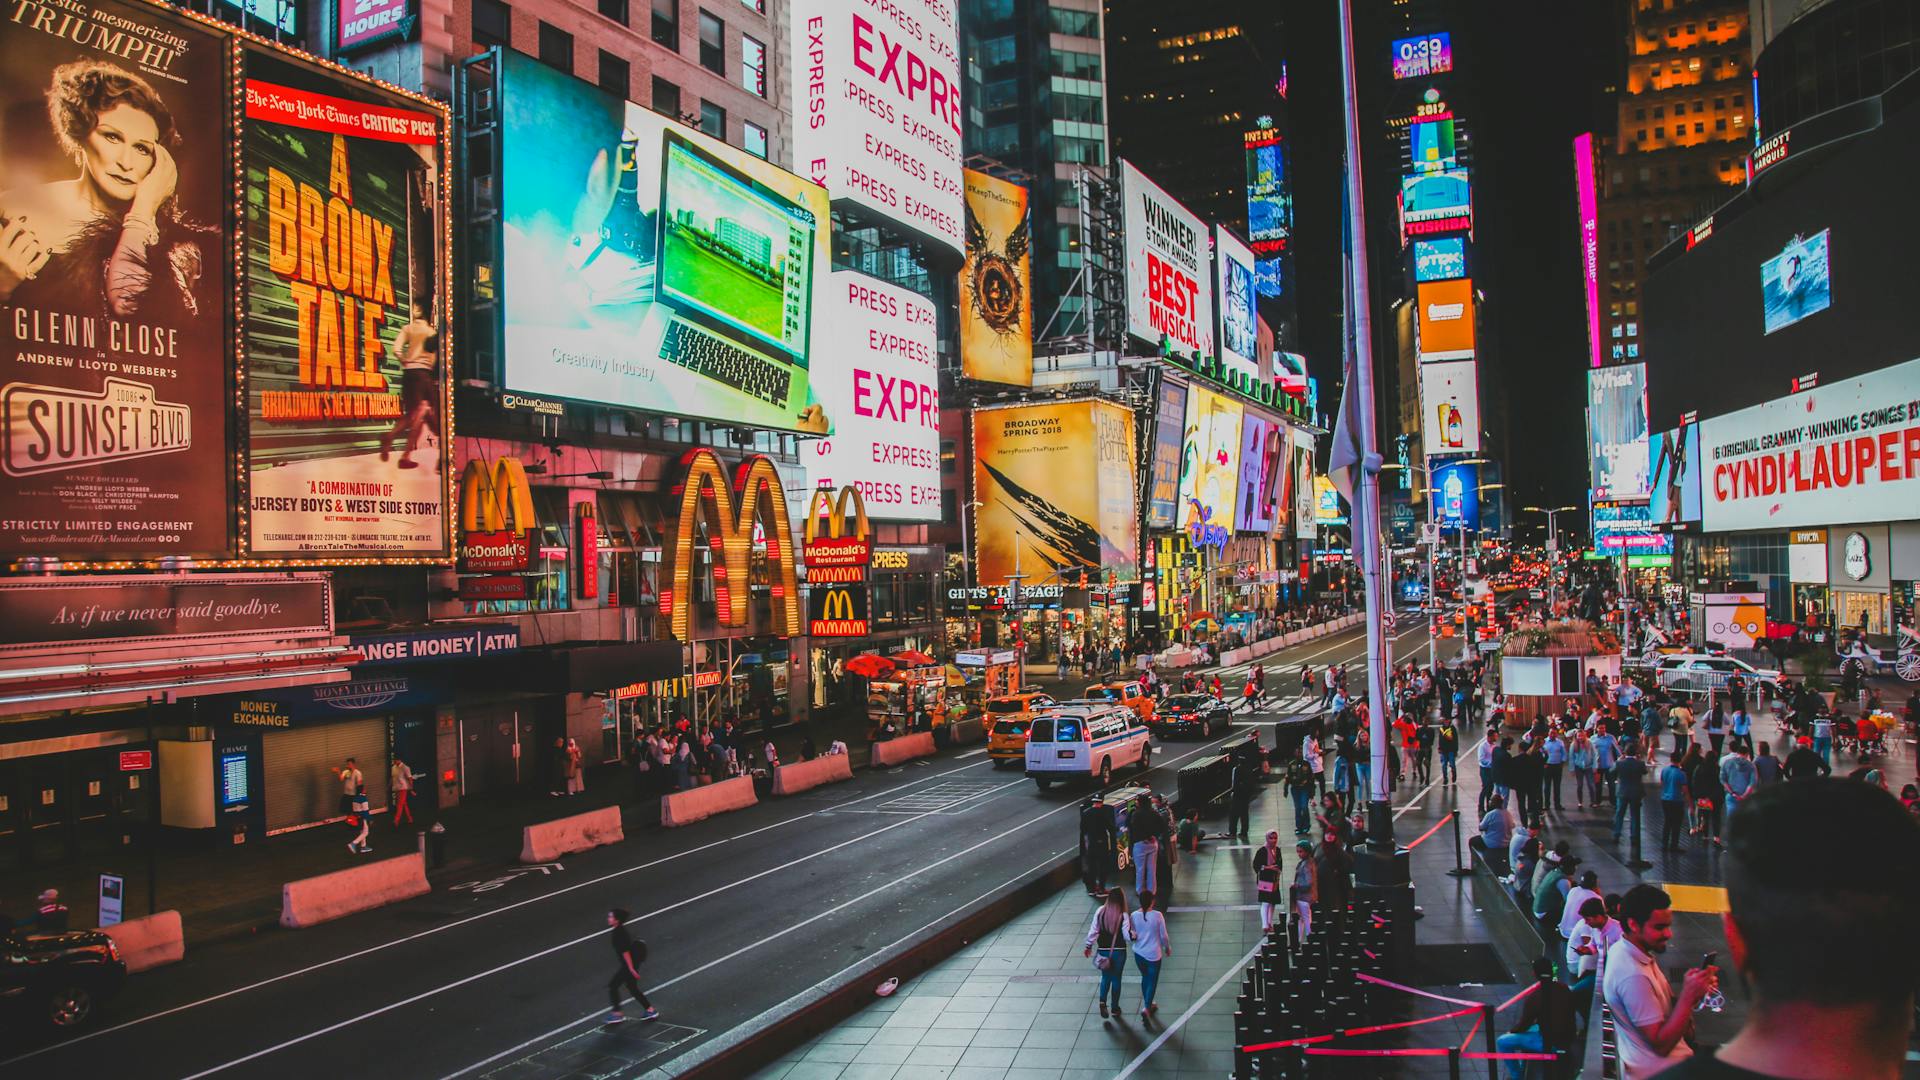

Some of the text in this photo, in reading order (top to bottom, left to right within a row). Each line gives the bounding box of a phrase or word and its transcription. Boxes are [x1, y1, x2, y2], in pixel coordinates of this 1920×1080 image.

[344, 5, 402, 38] HOURS
[864, 0, 922, 40] XPRESS
[1400, 38, 1441, 60] 0:39
[808, 15, 825, 130] EXPRESS
[853, 13, 960, 137] EXPRE
[246, 88, 437, 137] The New York Times CRITICS' PICK
[903, 114, 956, 161] EXPRESS
[1753, 131, 1790, 160] MARRIOTT
[329, 132, 351, 200] A
[865, 133, 926, 181] EXPRESS
[1754, 146, 1785, 172] MARQUIS
[905, 195, 958, 237] EXPRESS
[1143, 192, 1197, 257] WINNER!
[1405, 216, 1470, 235] TOSHIBA
[268, 166, 395, 306] BRONX
[1146, 228, 1197, 272] 6 TONY AWARDS
[1147, 251, 1199, 323] BEST
[15, 307, 177, 358] GLENN CLOSE
[290, 280, 385, 389] TALE
[1150, 301, 1200, 350] MUSICAL
[869, 329, 929, 365] EXPRESS
[17, 352, 177, 378] ANDREW LLOYD WEBBER'S
[552, 347, 655, 382] Creativity Industry
[1591, 371, 1633, 389] What
[261, 390, 330, 419] BROADWAY'S
[332, 392, 352, 417] NEW
[354, 393, 367, 416] HIT
[853, 368, 939, 431] EXPRE
[28, 399, 189, 462] SUNSET BLVD.
[1003, 426, 1062, 437] SPRING 2018
[1004, 418, 1060, 429] BROADWAY
[1712, 448, 1720, 461] 16
[1721, 438, 1759, 459] ORIGINAL
[1860, 403, 1906, 430] SONGS
[872, 442, 932, 469] EXPRESS
[997, 445, 1068, 456] HarryPotterThePlay.com
[1714, 427, 1920, 502] CYNDI LAUPER
[318, 481, 381, 496] COMBINATION
[383, 484, 393, 497] OF
[251, 497, 402, 514] JERSEY BOYS & WEST SIDE
[2, 520, 194, 531] STRICTLY LIMITED ENGAGEMENT
[20, 534, 157, 544] SunsetBoulevardTheMusical.com
[298, 543, 404, 551] ABronxTaleTheMusical.com
[462, 544, 526, 558] McDonald's
[805, 544, 866, 557] McDonald's
[815, 556, 856, 564] Restaurant
[51, 598, 281, 629] As if we never said goodbye.
[350, 633, 517, 661] ANGE MONEY ATM
[313, 679, 408, 697] MONEY EXCHANGE
[233, 713, 289, 727] EXCHANGE
[240, 701, 277, 714] MONEY
[222, 745, 248, 753] CHANGE
